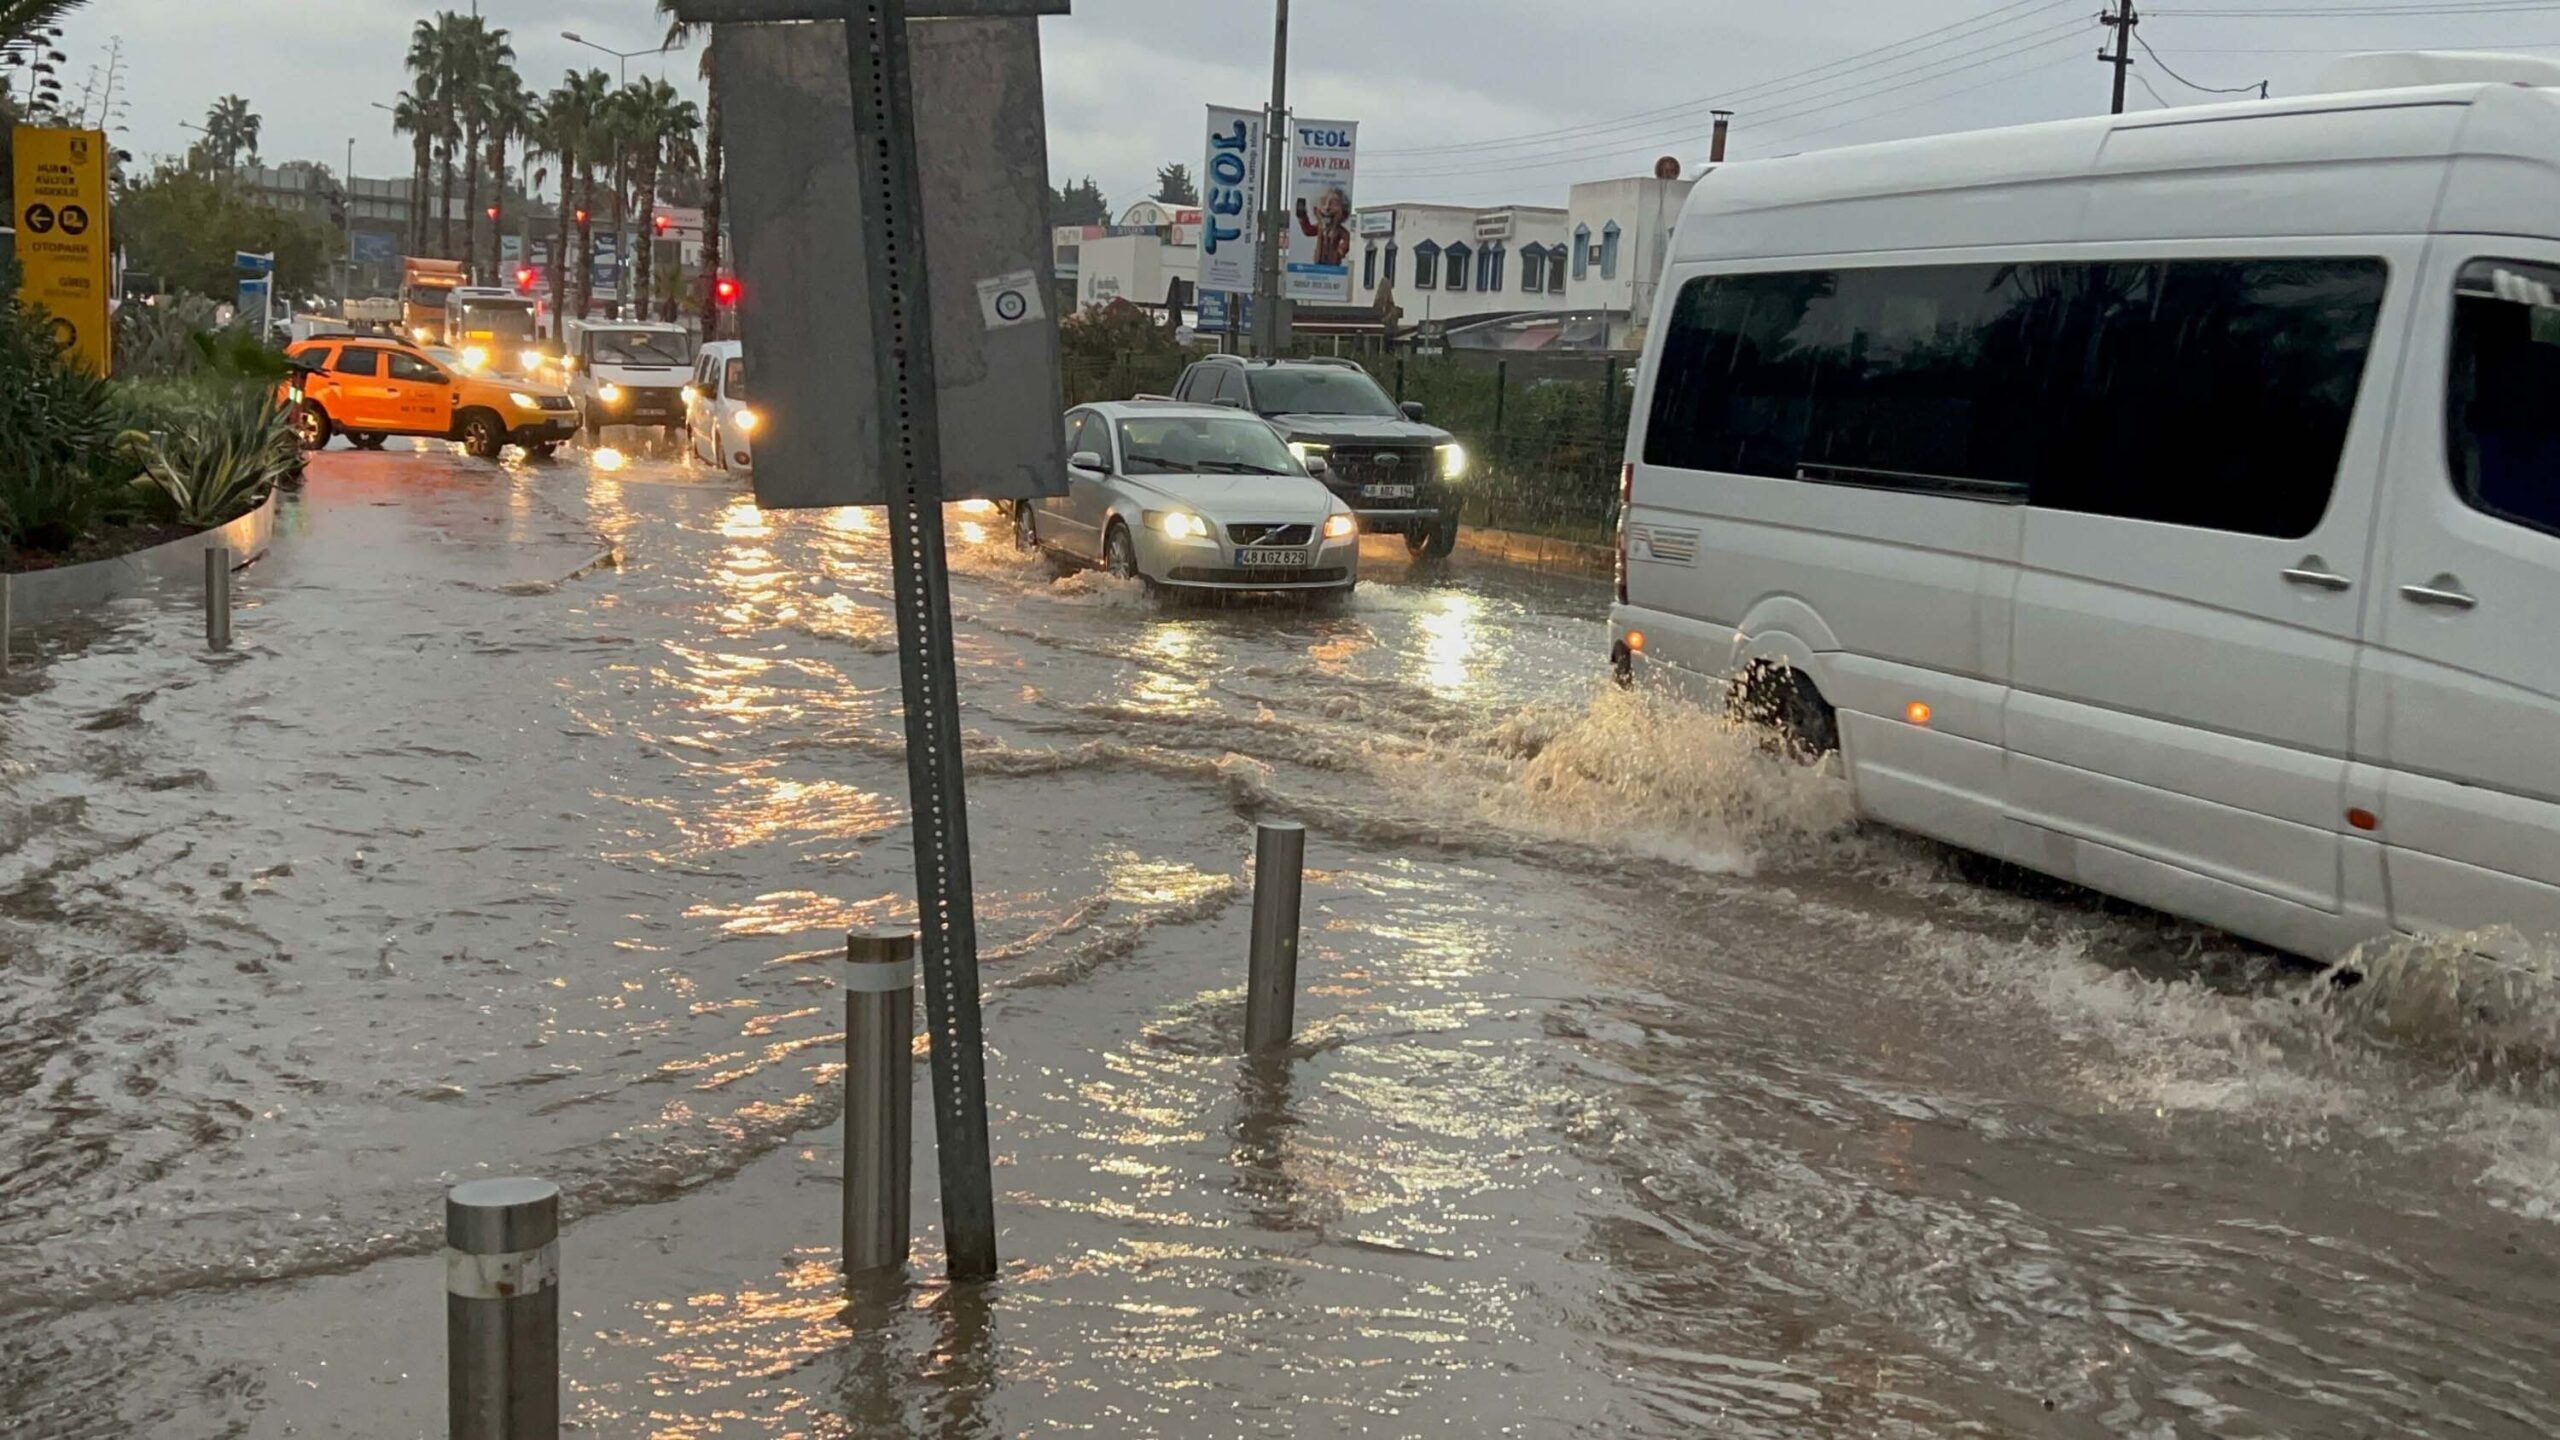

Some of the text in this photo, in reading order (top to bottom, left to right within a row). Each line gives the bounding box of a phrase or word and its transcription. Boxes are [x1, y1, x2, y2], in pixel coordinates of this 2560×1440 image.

[1298, 128, 1351, 147] TEOL
[1297, 155, 1350, 170] YAPAY ZEKA
[1205, 120, 1246, 255] TEOL
[32, 242, 88, 254] OTOPARK
[1283, 551, 1305, 564] 829
